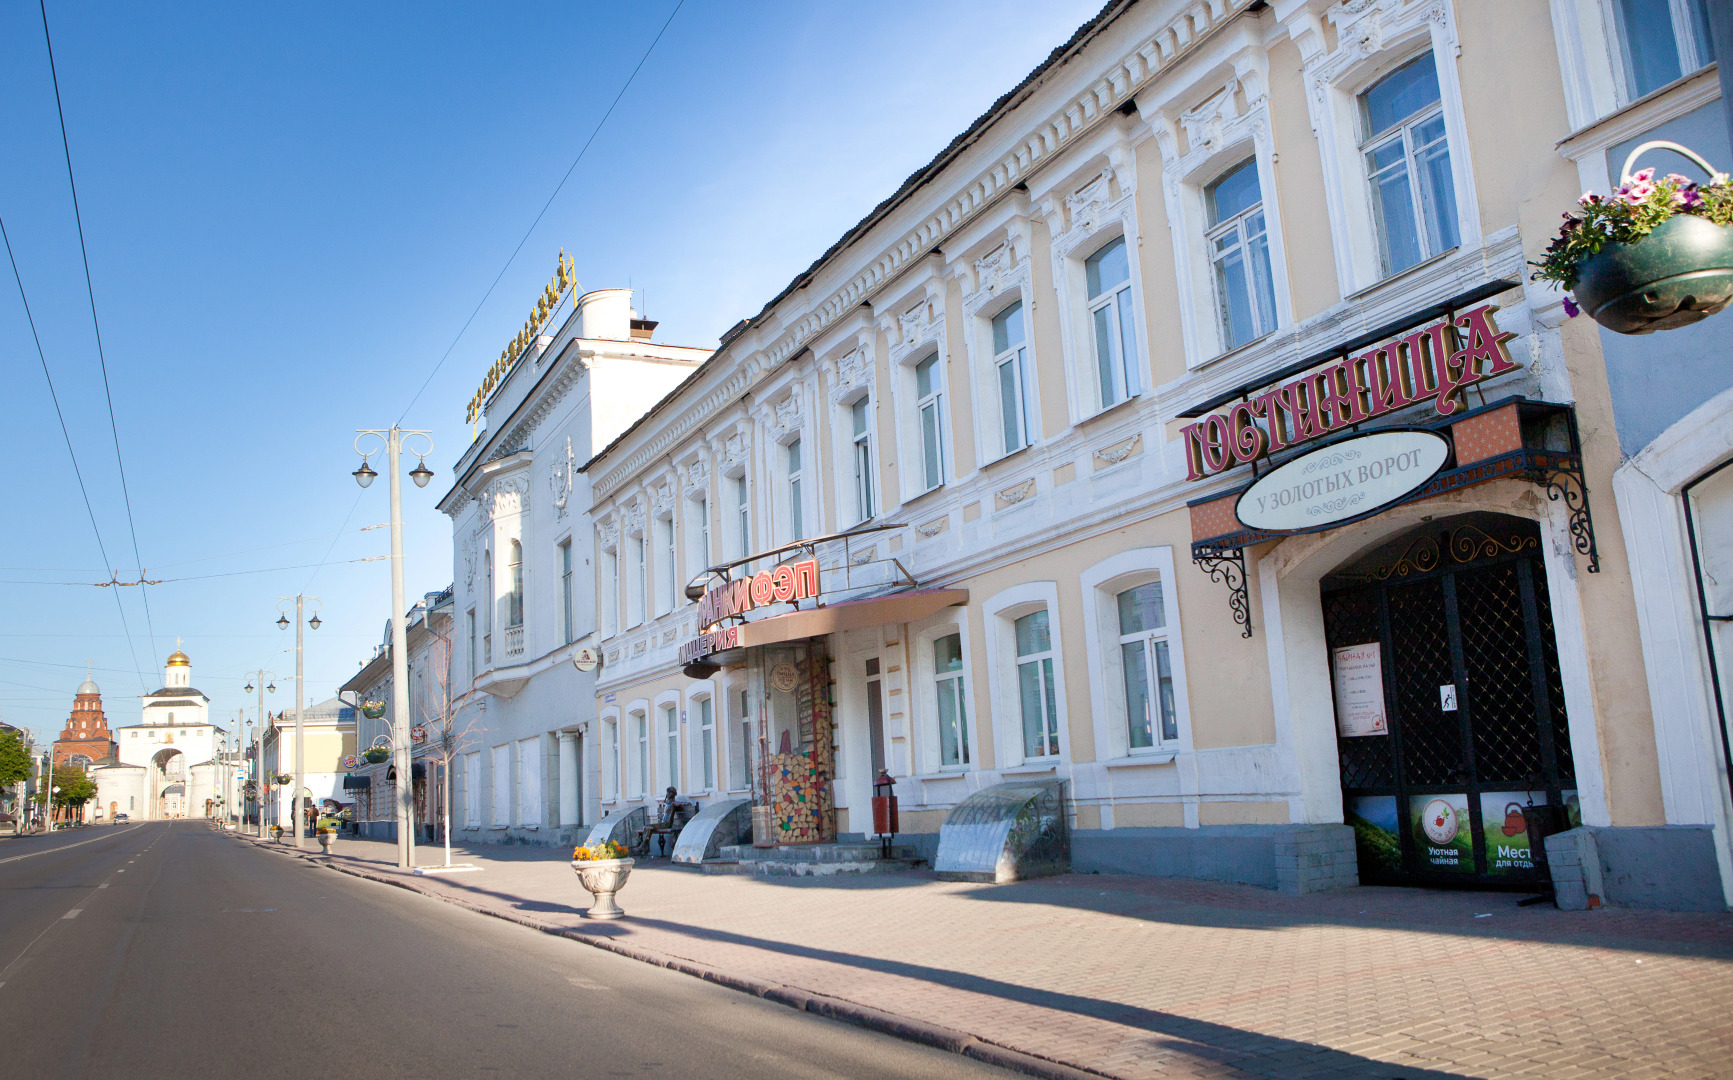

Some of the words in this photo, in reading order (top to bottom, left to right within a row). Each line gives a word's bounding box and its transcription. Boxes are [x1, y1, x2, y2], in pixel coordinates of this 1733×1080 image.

[1179, 304, 1518, 482] ГОСТИНИЦА
[1256, 497, 1266, 513] У
[1270, 470, 1353, 510] ЗОЛОТЫХ
[1357, 449, 1421, 483] ВОРОТ
[751, 560, 818, 605] ФЭП
[679, 626, 738, 665] ПИЦЦЕРИЯ
[1428, 847, 1459, 856] Уютная
[1430, 857, 1459, 865] чайная
